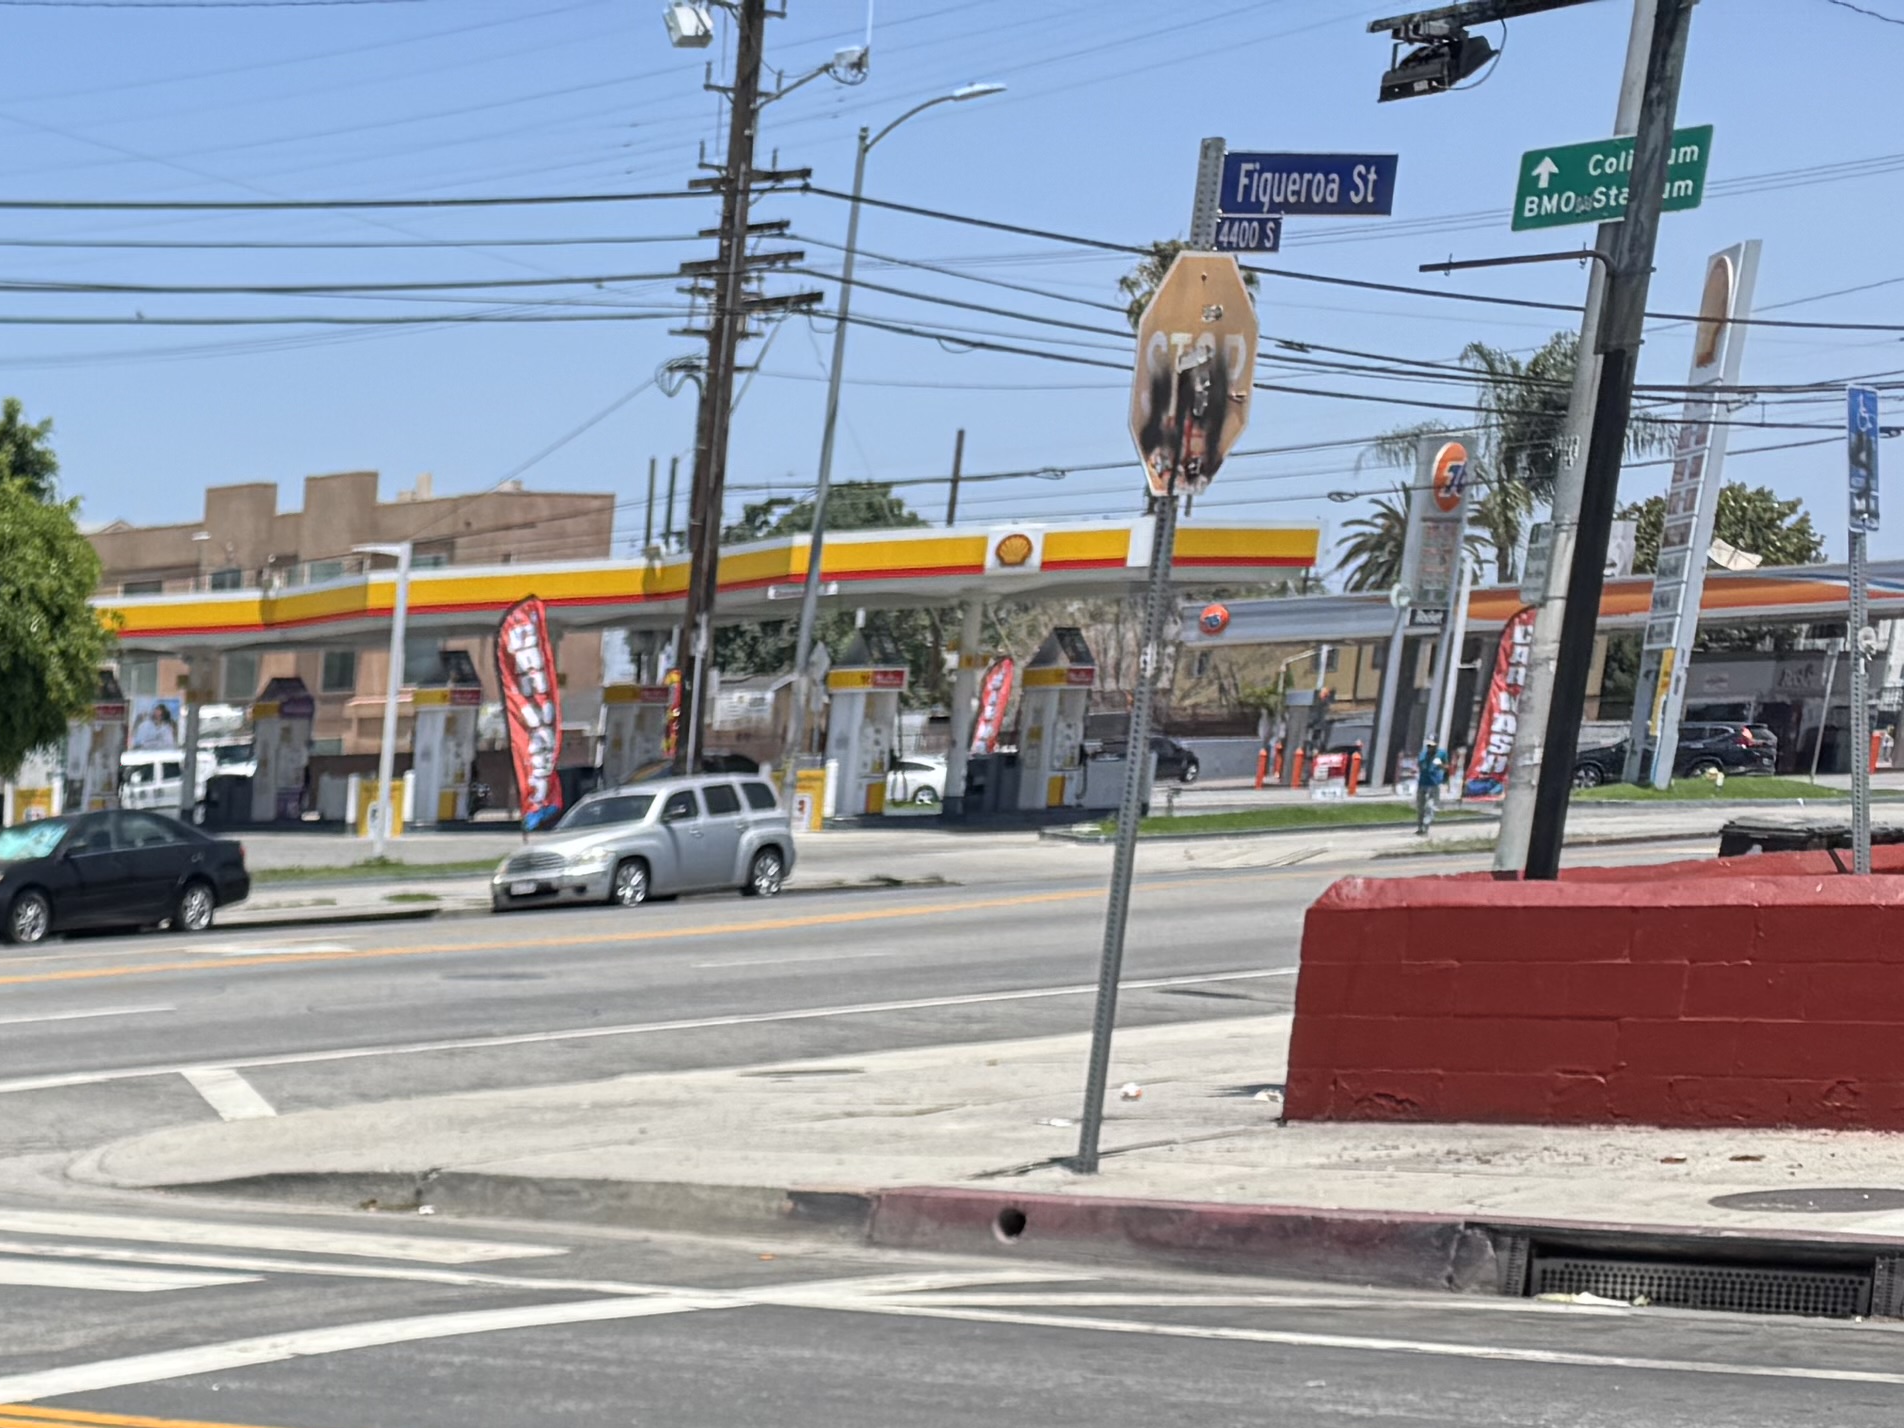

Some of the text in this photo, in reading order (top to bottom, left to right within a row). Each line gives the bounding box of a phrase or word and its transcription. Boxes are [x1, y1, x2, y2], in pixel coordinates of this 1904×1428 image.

[1589, 144, 1699, 176] Colium
[1237, 162, 1378, 214] Figueroa St
[1523, 179, 1693, 217] BMO Staum
[1218, 219, 1276, 248] 4400 S
